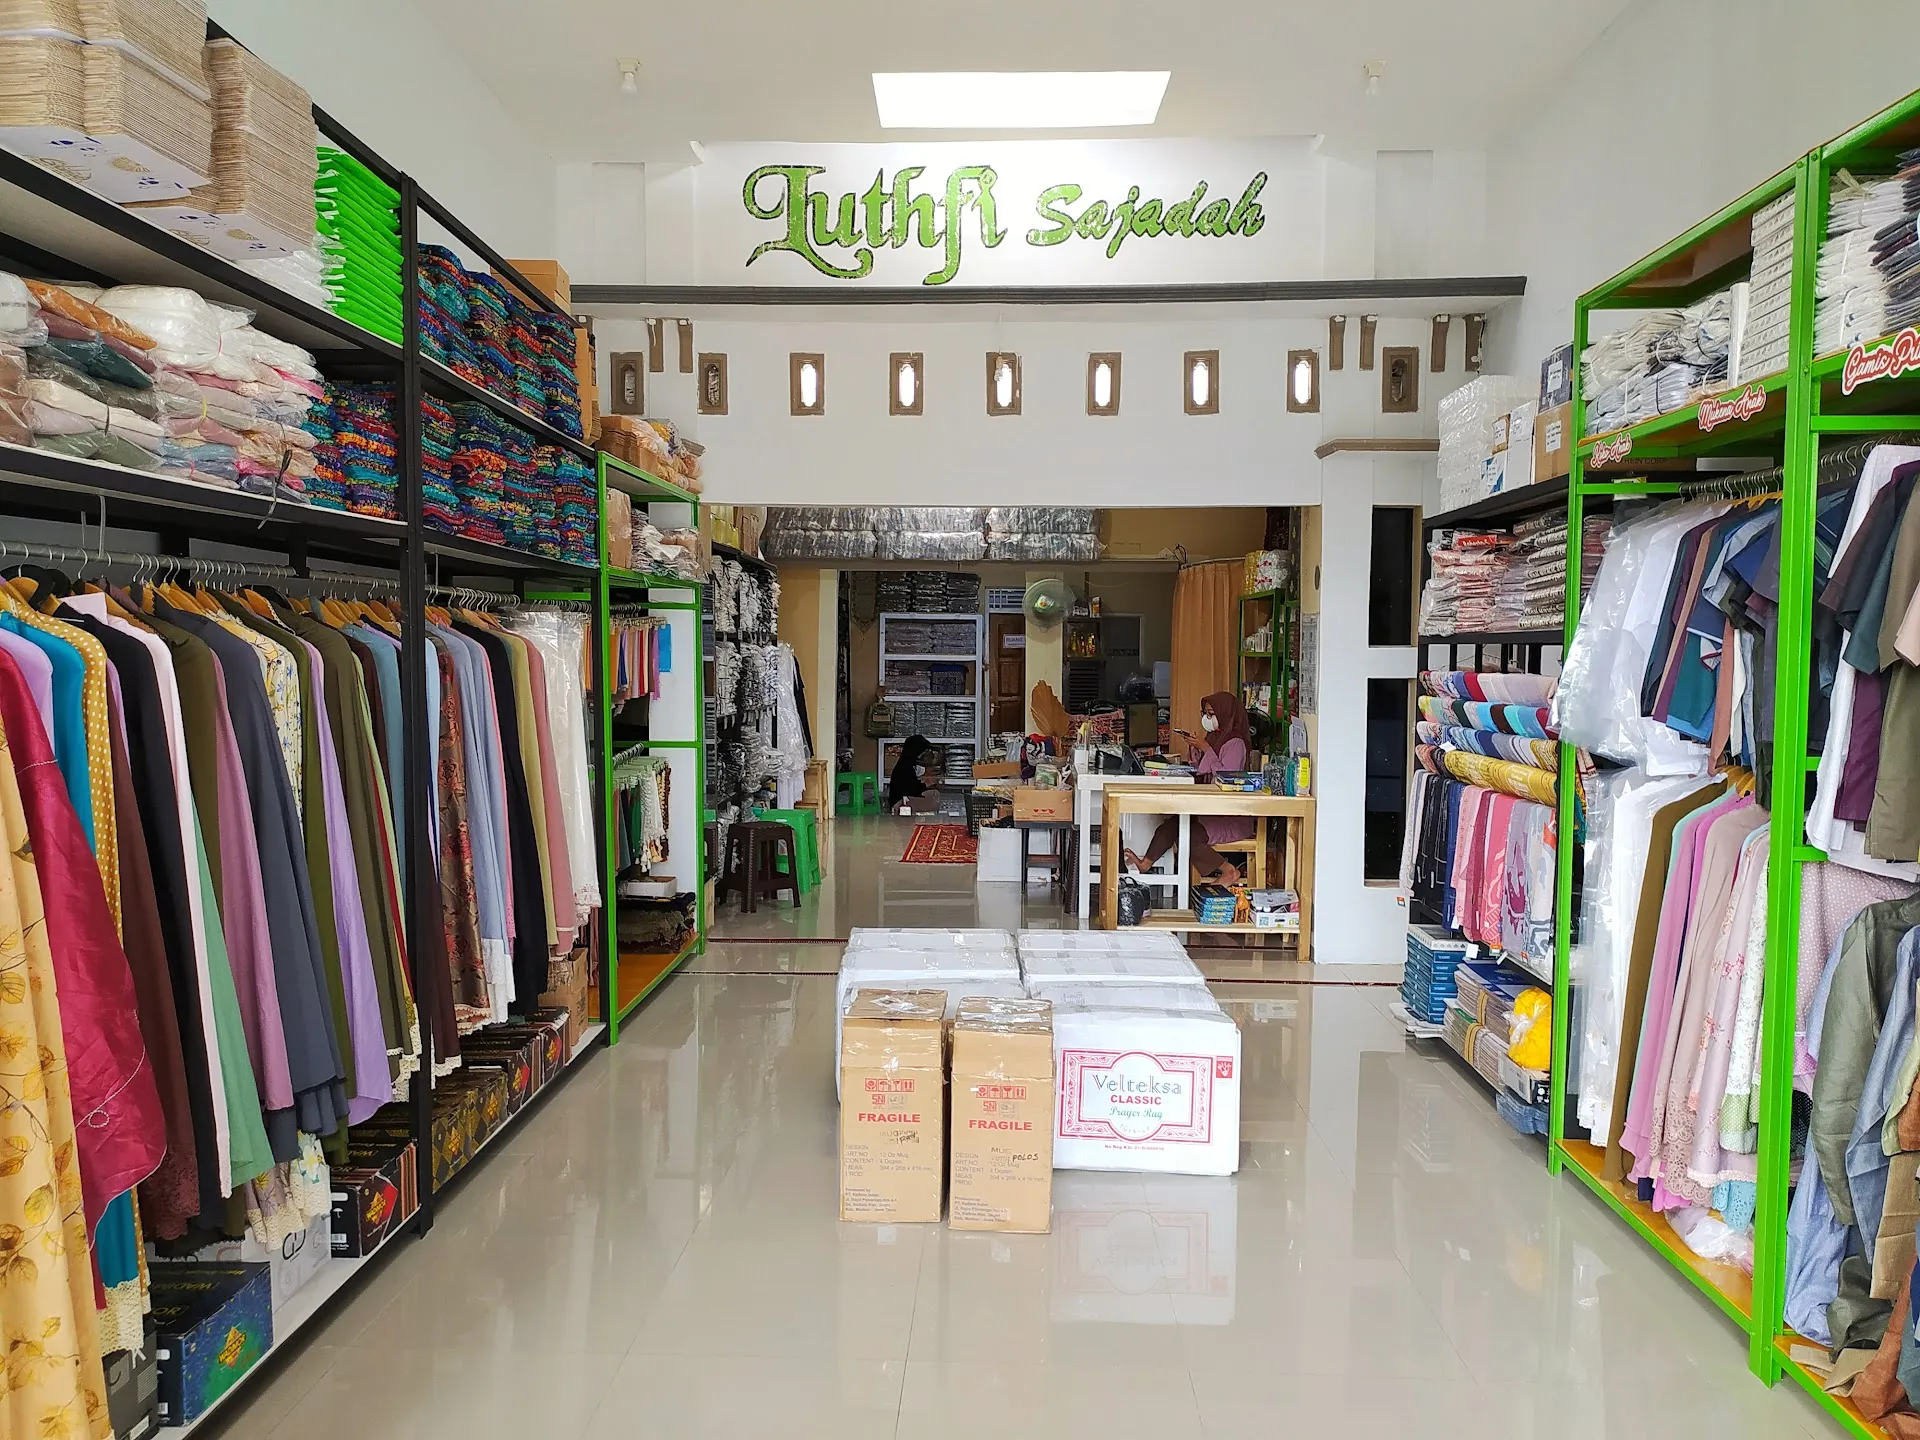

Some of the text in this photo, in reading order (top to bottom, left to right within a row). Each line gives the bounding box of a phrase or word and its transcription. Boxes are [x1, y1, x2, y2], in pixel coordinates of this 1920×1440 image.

[742, 164, 1268, 286] Luthfi Sajadah
[1845, 346, 1892, 391] Gamis
[1734, 387, 1765, 418] Anak
[1092, 1074, 1182, 1095] Velteksa
[1110, 1094, 1162, 1105] CLASSIC
[858, 1113, 921, 1123] FRAGILE
[1109, 1106, 1163, 1120] Prayer Rug
[969, 1120, 1032, 1131] FRAGILE
[1012, 1153, 1039, 1162] POLOS
